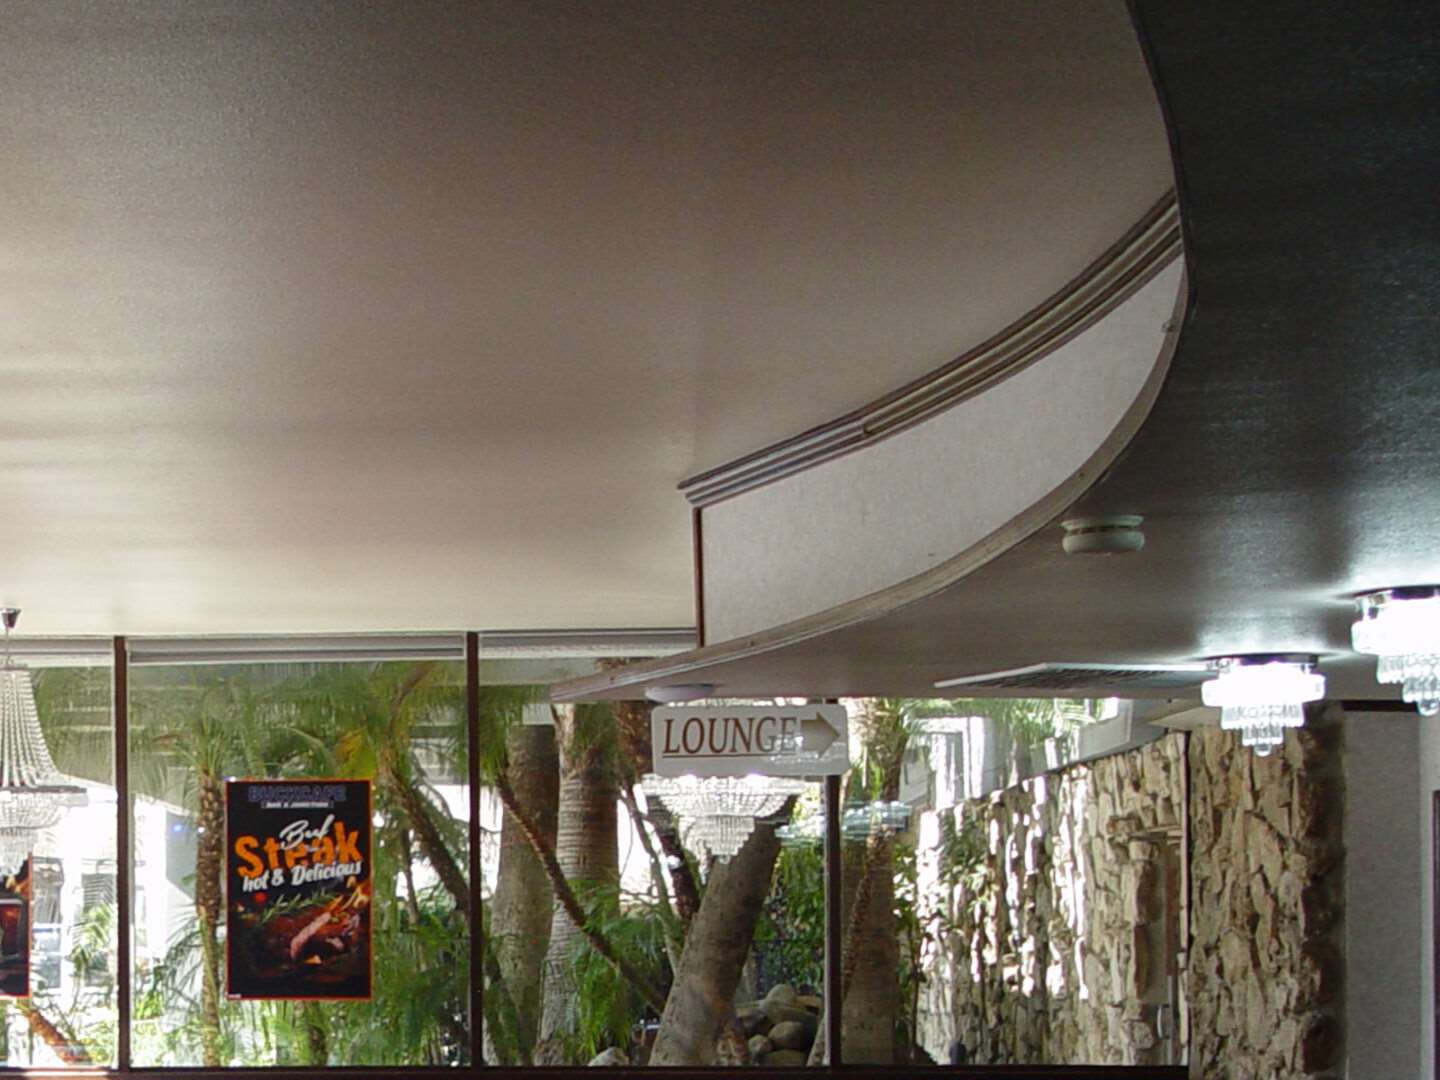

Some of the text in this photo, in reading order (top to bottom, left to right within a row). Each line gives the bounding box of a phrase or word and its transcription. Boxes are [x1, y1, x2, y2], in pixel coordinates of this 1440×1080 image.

[663, 716, 798, 754] LOUNGE
[233, 820, 363, 878] Steak
[242, 860, 363, 893] hot & Delicious
